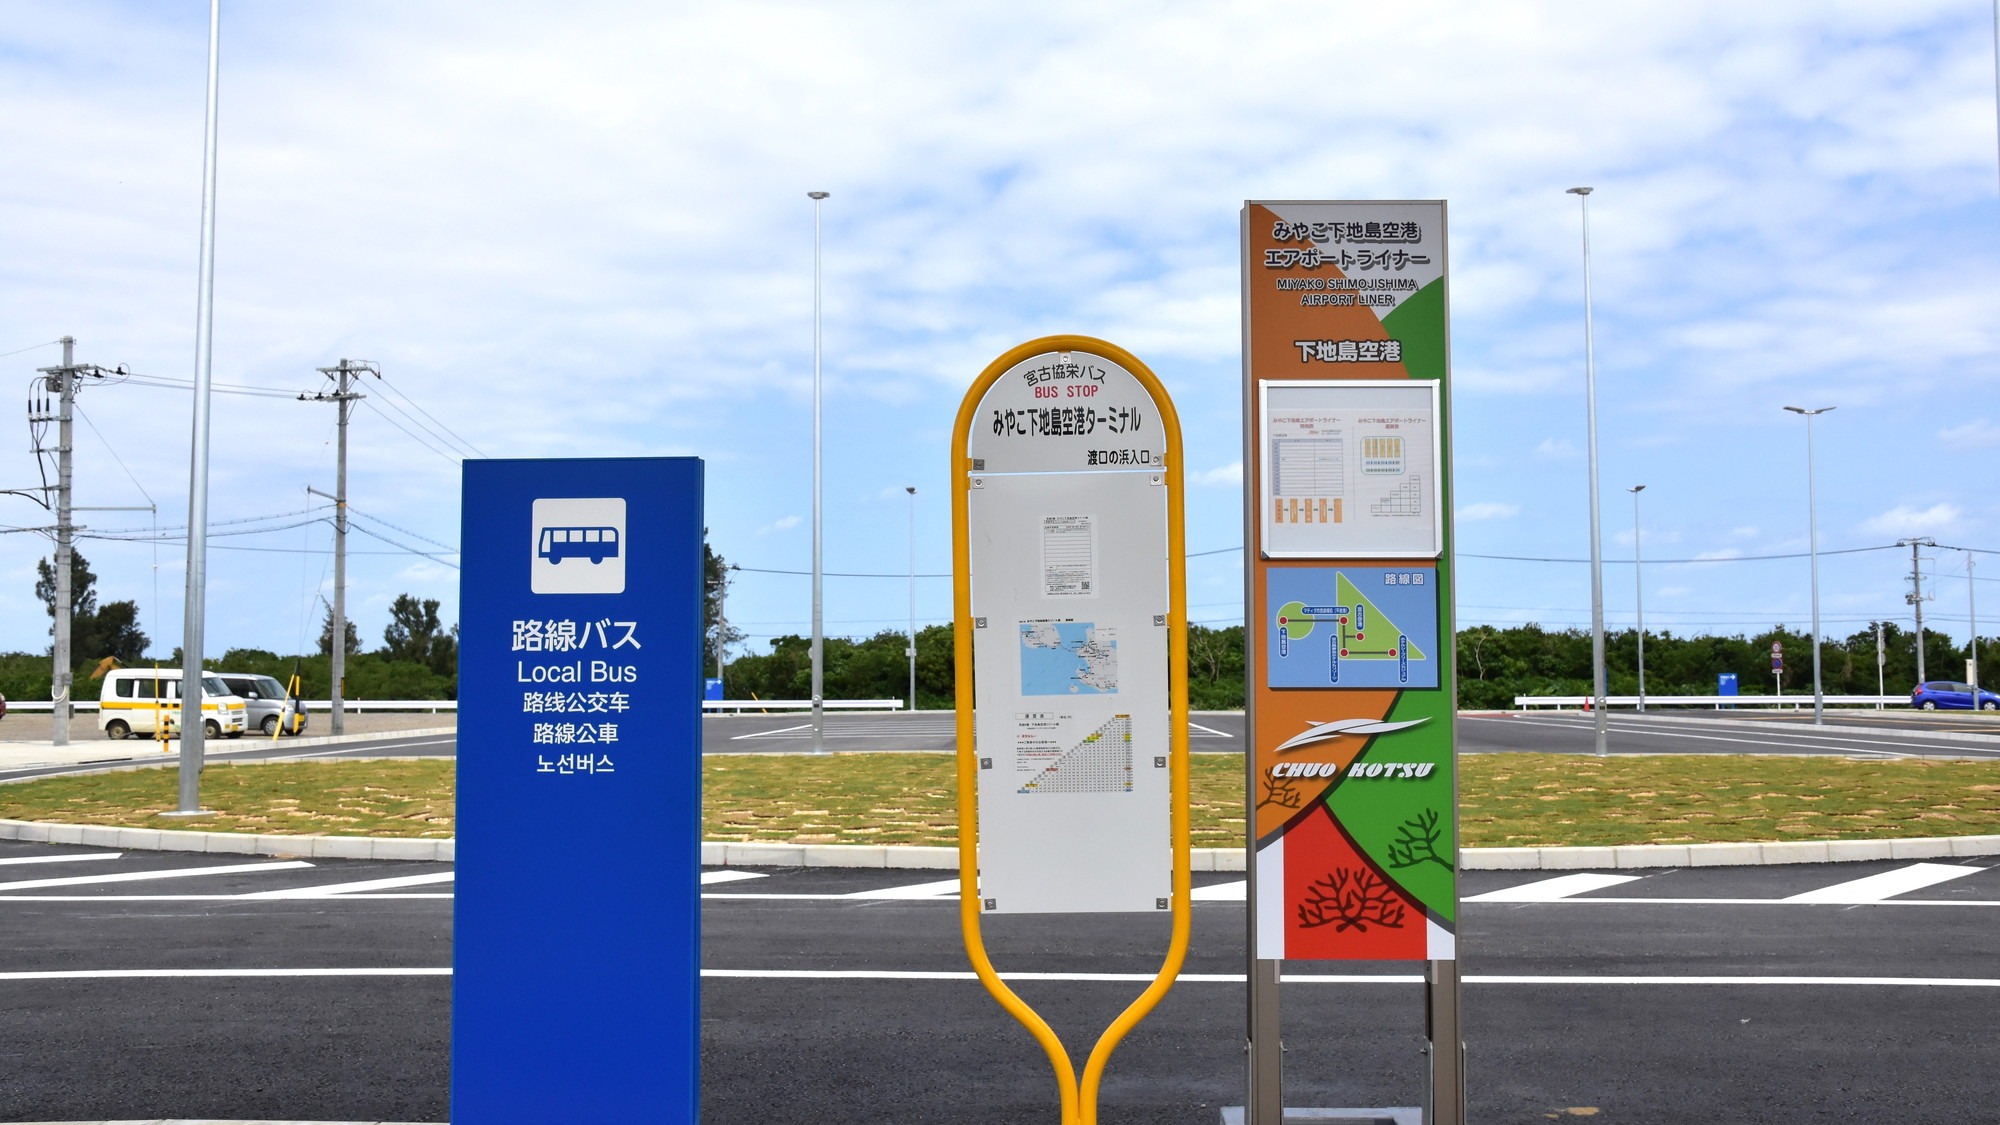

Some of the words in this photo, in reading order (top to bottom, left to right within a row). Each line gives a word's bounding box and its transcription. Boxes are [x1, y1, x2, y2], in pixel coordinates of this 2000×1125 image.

[1273, 221, 1419, 240] みやこ下地島空港
[1265, 249, 1428, 266] エアポートライナー
[1277, 278, 1324, 290] MIYAKO
[1328, 278, 1417, 290] SHIMOJISHIMA
[1301, 294, 1355, 305] AIRPORT
[1358, 294, 1394, 305] LINER
[1294, 340, 1402, 363] 下地島空港
[1023, 364, 1106, 387] 宮古協栄バス
[1034, 386, 1058, 398] BUS
[1066, 385, 1099, 398] STOP
[993, 406, 1141, 437] みやこ下地島空港ターミナル
[1087, 449, 1150, 466] 渡口の浜入口
[1384, 573, 1425, 586] 路線図
[511, 618, 642, 652] 路線バス
[517, 661, 582, 683] Local
[590, 661, 638, 683] Bus
[523, 692, 630, 713] 路线公交车
[533, 723, 619, 744] 路線公車
[536, 753, 615, 774] 노선버스
[1272, 762, 1337, 778] CHUO
[1347, 762, 1435, 778] KOTSU
